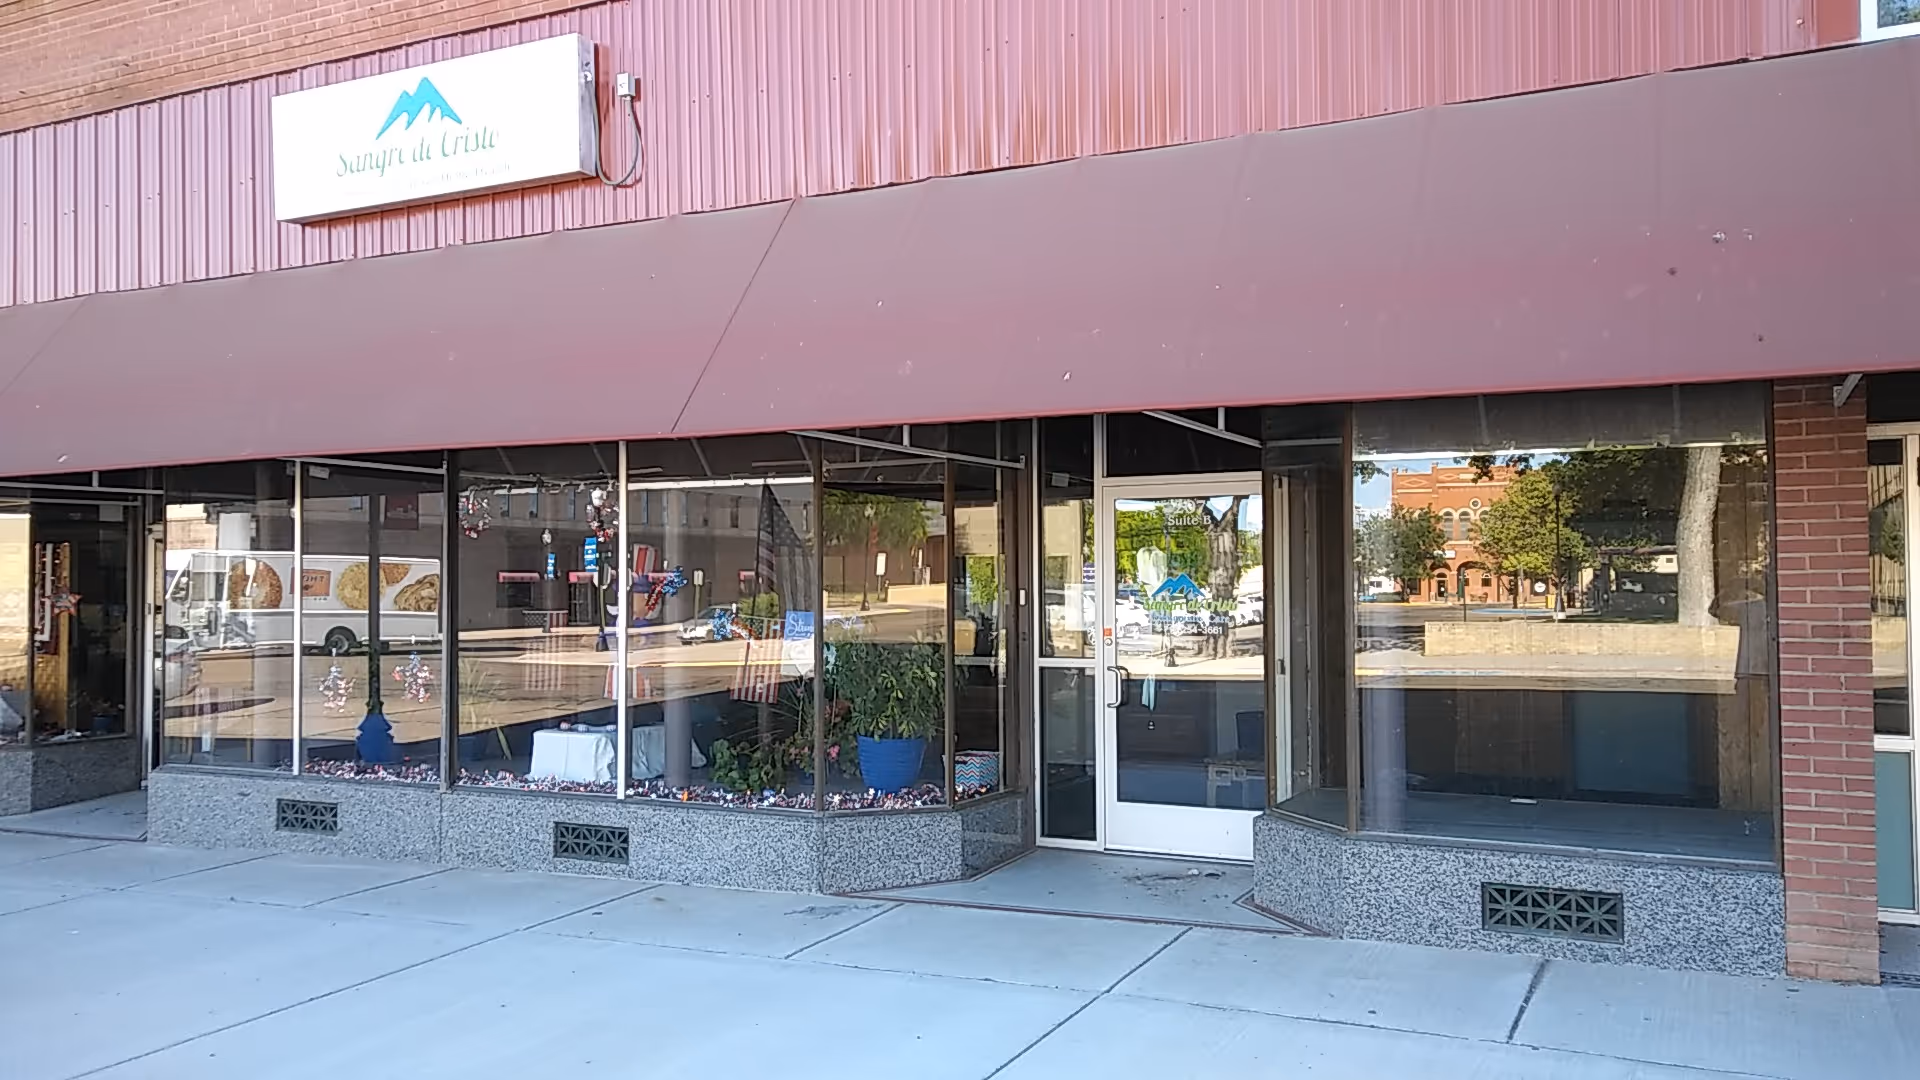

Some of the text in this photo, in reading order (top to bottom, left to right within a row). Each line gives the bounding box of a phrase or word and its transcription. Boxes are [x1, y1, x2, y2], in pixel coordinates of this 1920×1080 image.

[336, 146, 405, 178] Sangre
[441, 125, 500, 157] Cristo
[1167, 515, 1212, 526] Suite B
